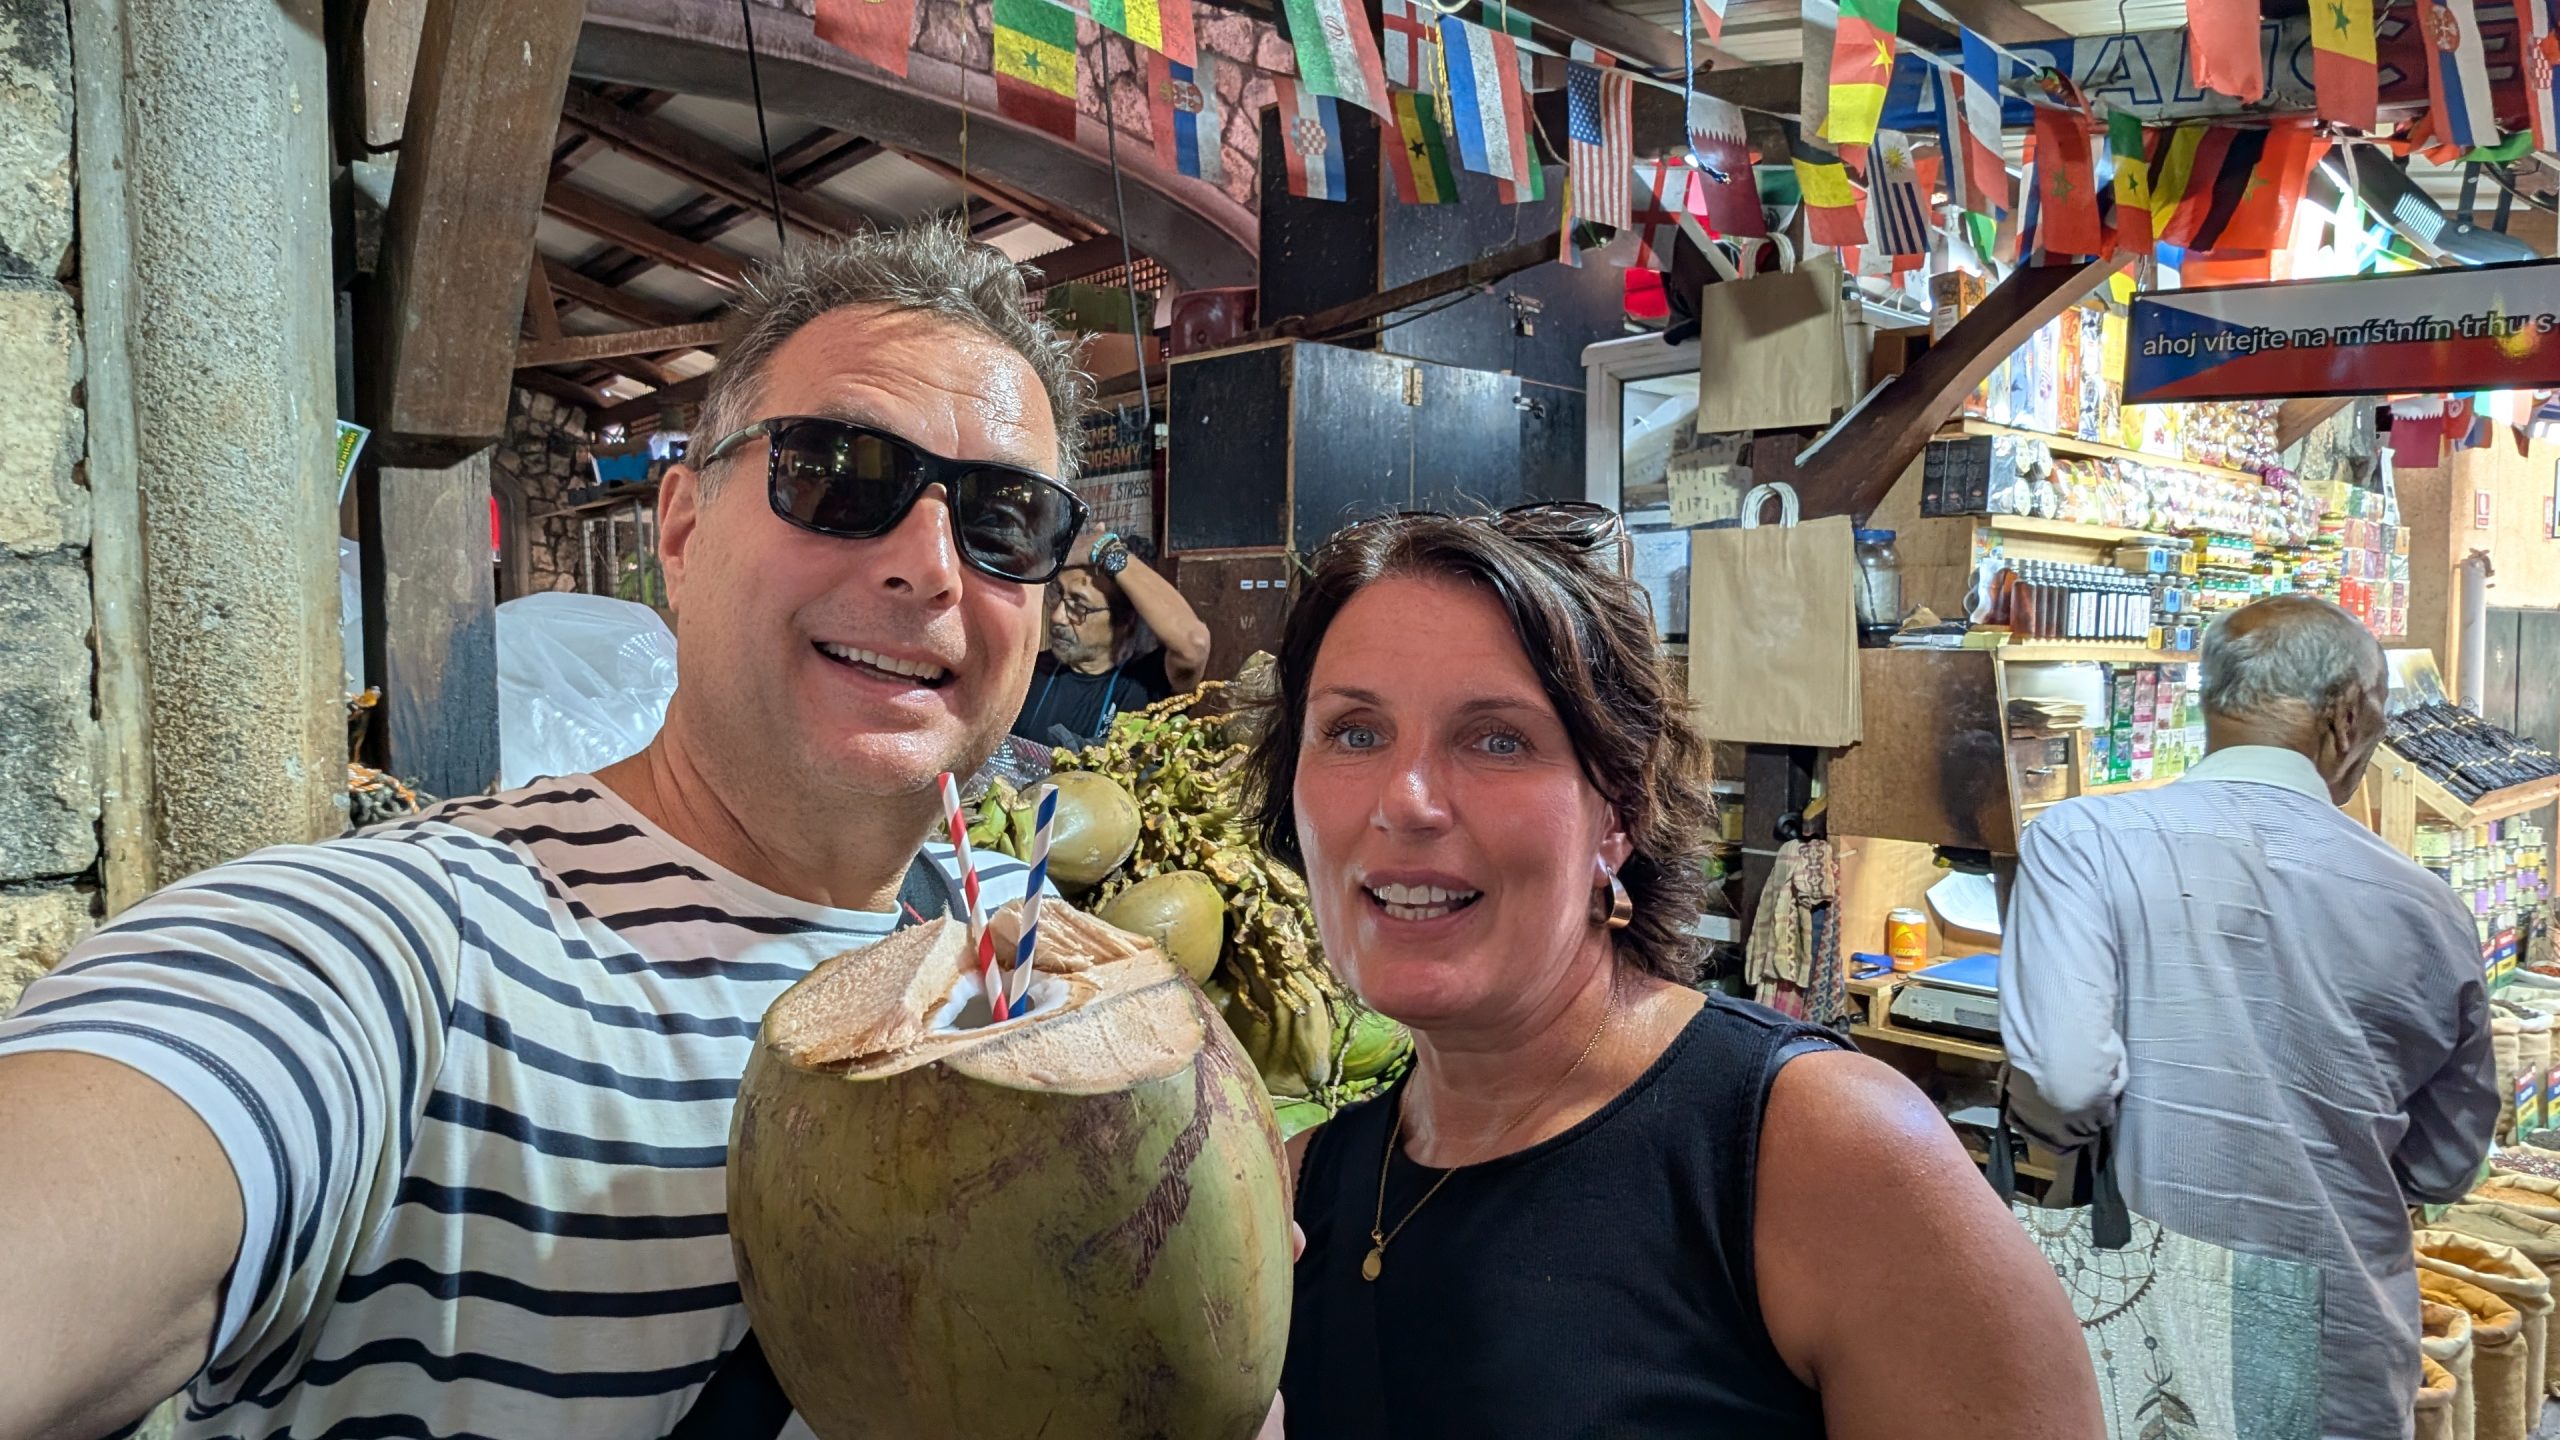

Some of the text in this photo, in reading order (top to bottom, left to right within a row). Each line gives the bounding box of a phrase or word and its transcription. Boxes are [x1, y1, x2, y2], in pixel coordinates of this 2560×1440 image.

[2143, 311, 2554, 358] ahoj vítejte na místním trhu s
[1116, 480, 1151, 500] STRESS
